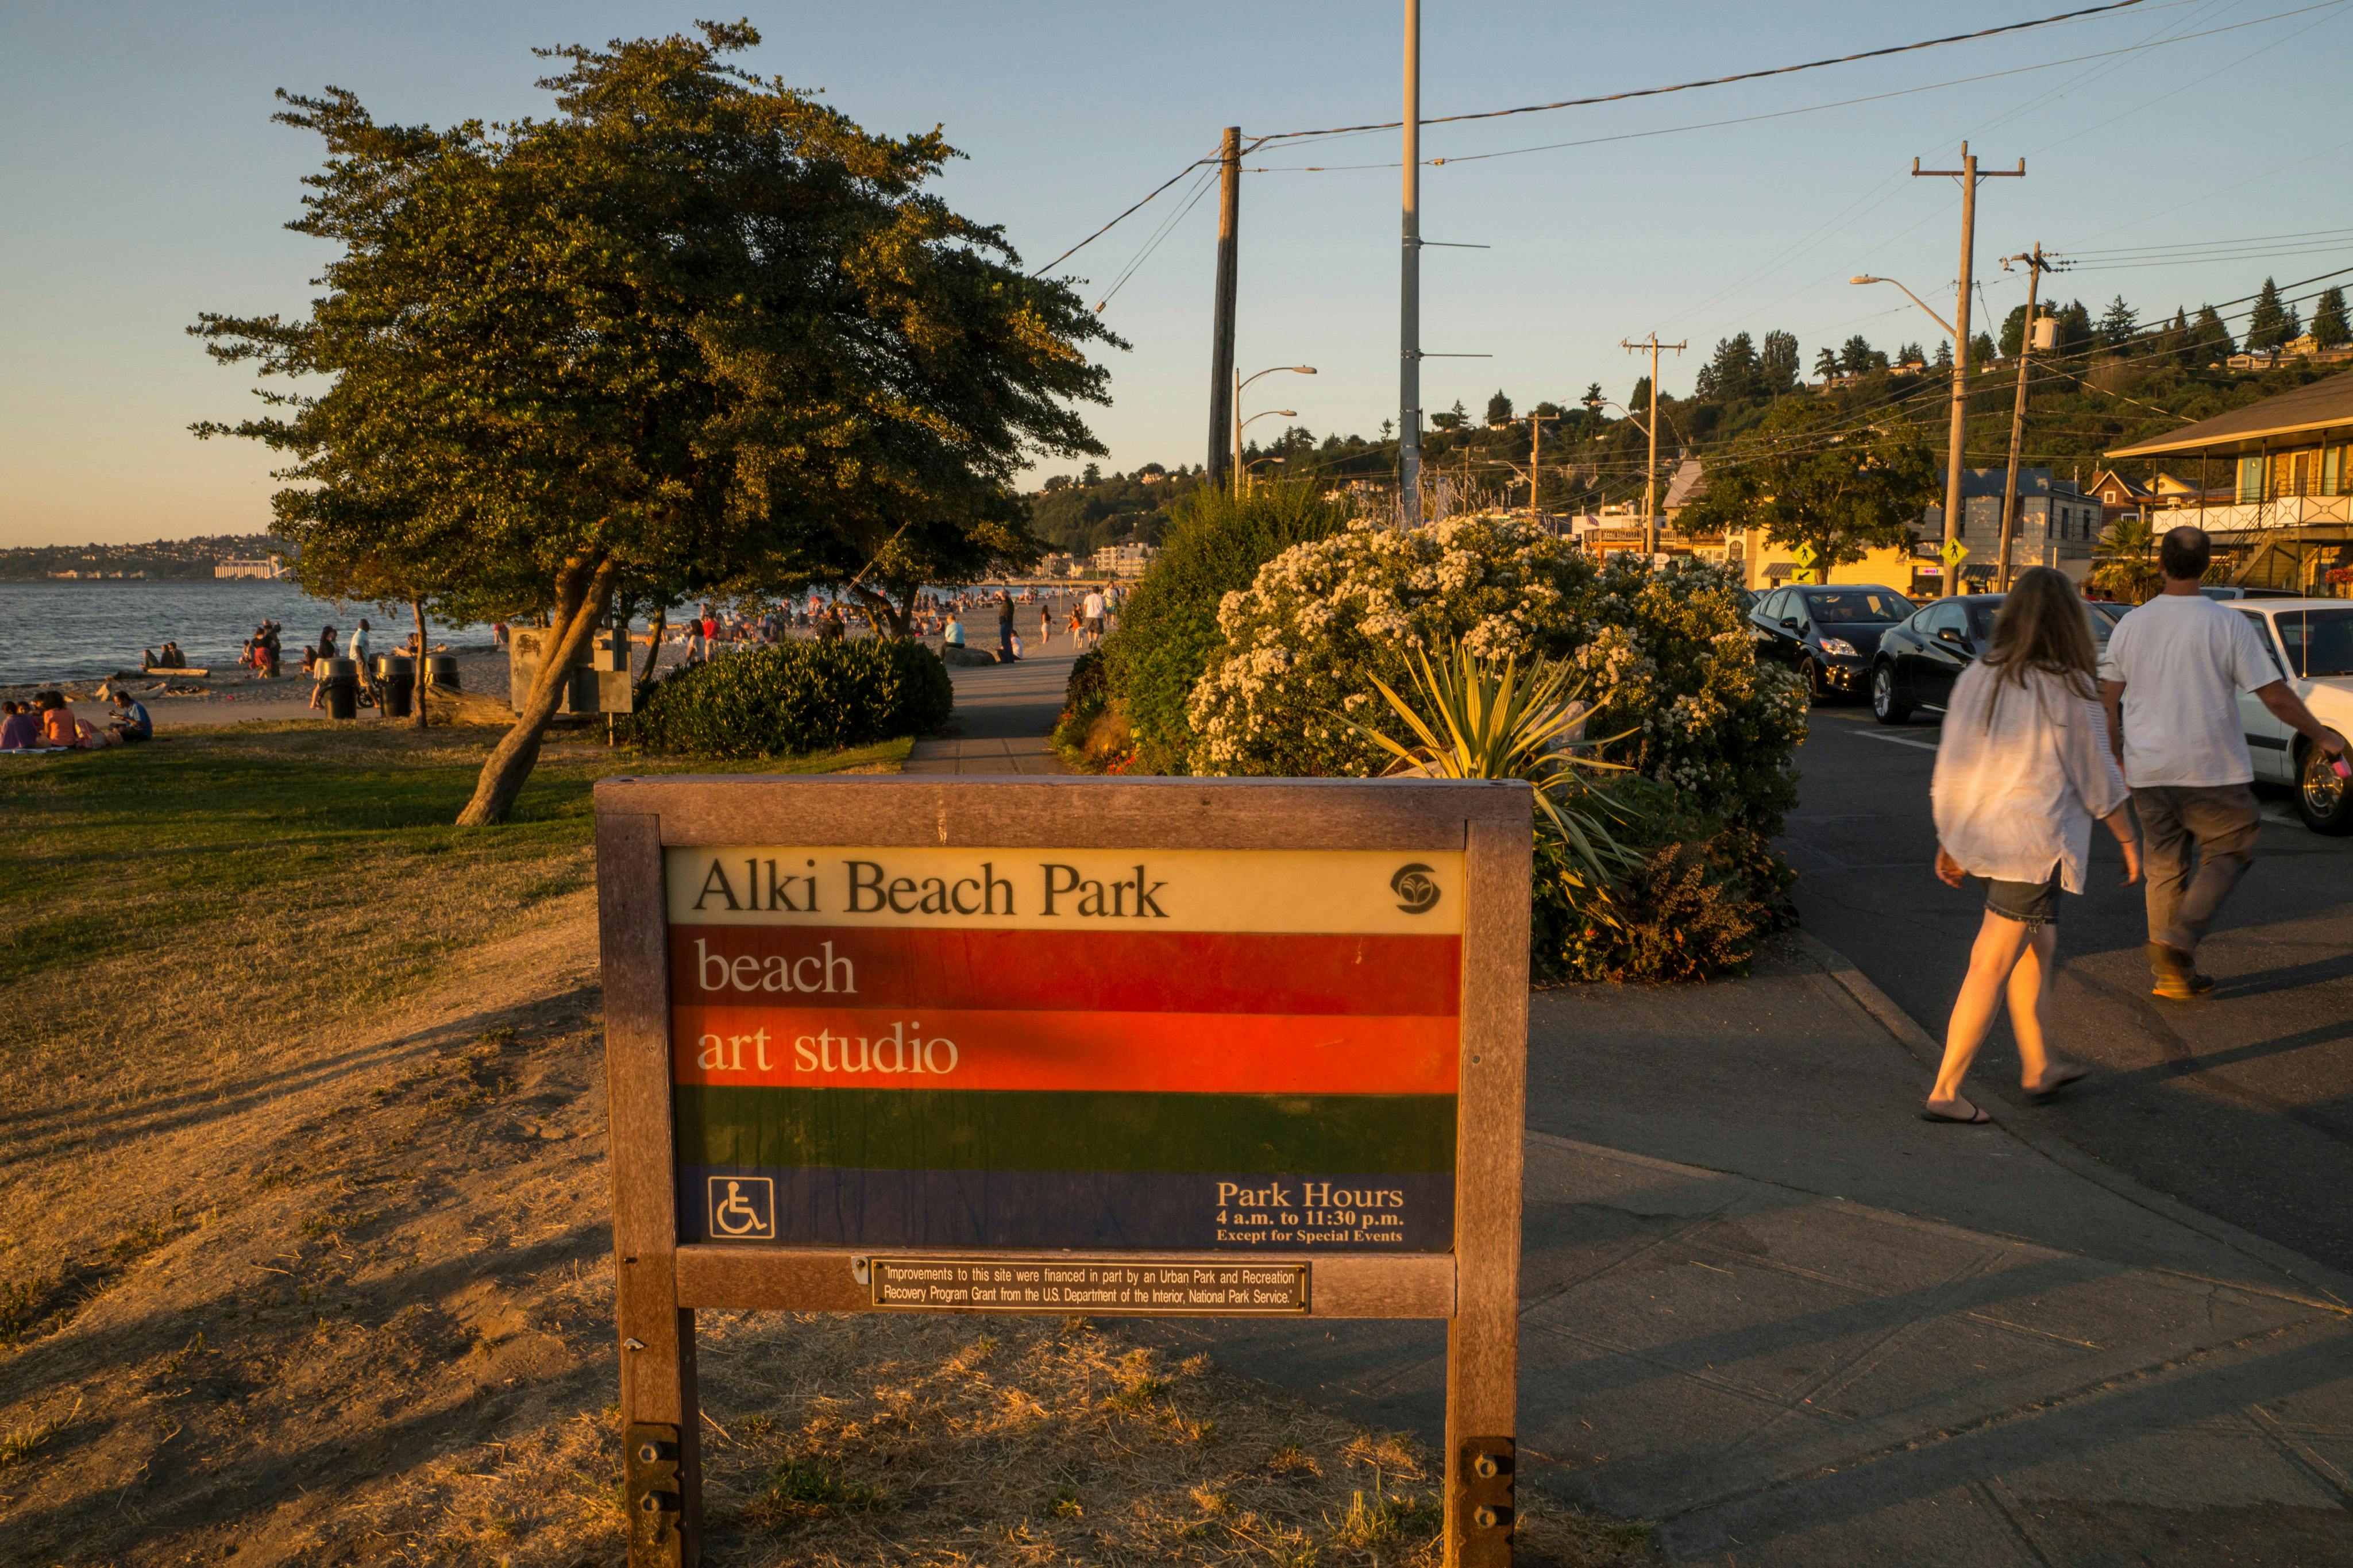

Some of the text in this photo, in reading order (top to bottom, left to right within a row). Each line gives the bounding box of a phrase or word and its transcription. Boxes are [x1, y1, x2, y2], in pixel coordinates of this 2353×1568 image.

[692, 858, 1169, 917] Alki Beach Park
[694, 938, 858, 993] beach
[697, 1021, 958, 1074] art studio
[1216, 1182, 1403, 1207] Park Hours
[1216, 1210, 1403, 1229] 4 a.m. to 11:30 p.m.
[1217, 1229, 1402, 1245] Except for Special Events
[958, 1268, 967, 1280] to
[973, 1268, 989, 1281] this
[994, 1268, 1011, 1281] site
[1016, 1272, 1039, 1281] were
[1044, 1268, 1085, 1282] financed
[1090, 1269, 1098, 1282] in
[1103, 1270, 1122, 1285] part
[1127, 1269, 1139, 1285] by
[1144, 1273, 1155, 1283] an
[1160, 1270, 1189, 1283] Urban
[1194, 1270, 1215, 1283] Park
[1220, 1270, 1237, 1283] and
[1243, 1270, 1294, 1284] Recreation
[885, 1285, 926, 1300] Recovery
[931, 1286, 967, 1302] Program
[972, 1287, 996, 1300] Grant
[1001, 1287, 1020, 1301] from
[1025, 1288, 1039, 1301] the
[1043, 1288, 1060, 1301] U.S.
[1065, 1288, 1116, 1304] Department
[1121, 1288, 1130, 1302] of
[1135, 1289, 1148, 1302] the
[1153, 1289, 1185, 1304] Interior,
[1190, 1289, 1225, 1303] National
[1229, 1289, 1249, 1303] Park
